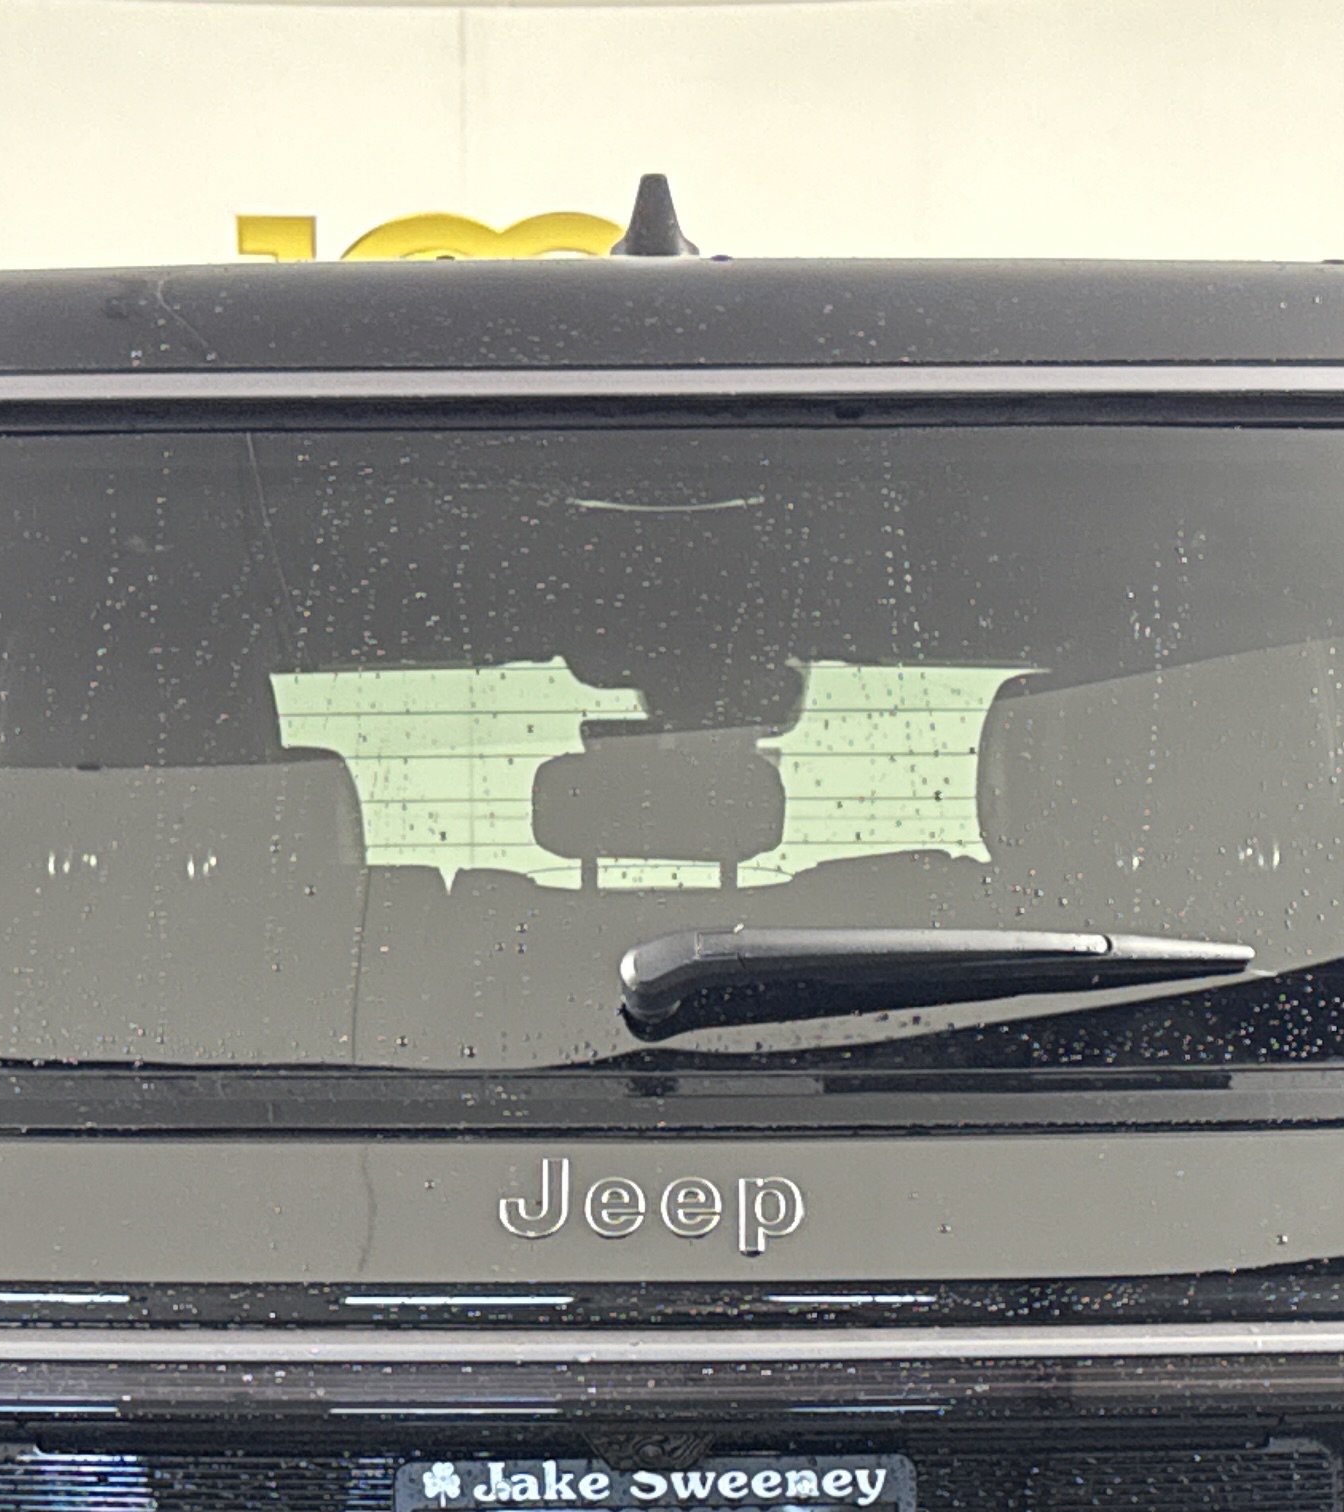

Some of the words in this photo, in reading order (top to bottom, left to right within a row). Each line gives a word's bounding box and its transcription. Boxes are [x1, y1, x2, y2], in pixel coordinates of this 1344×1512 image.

[498, 1157, 805, 1256] Jeep
[473, 1460, 610, 1501] Jake
[630, 1468, 886, 1505] Sweeney
